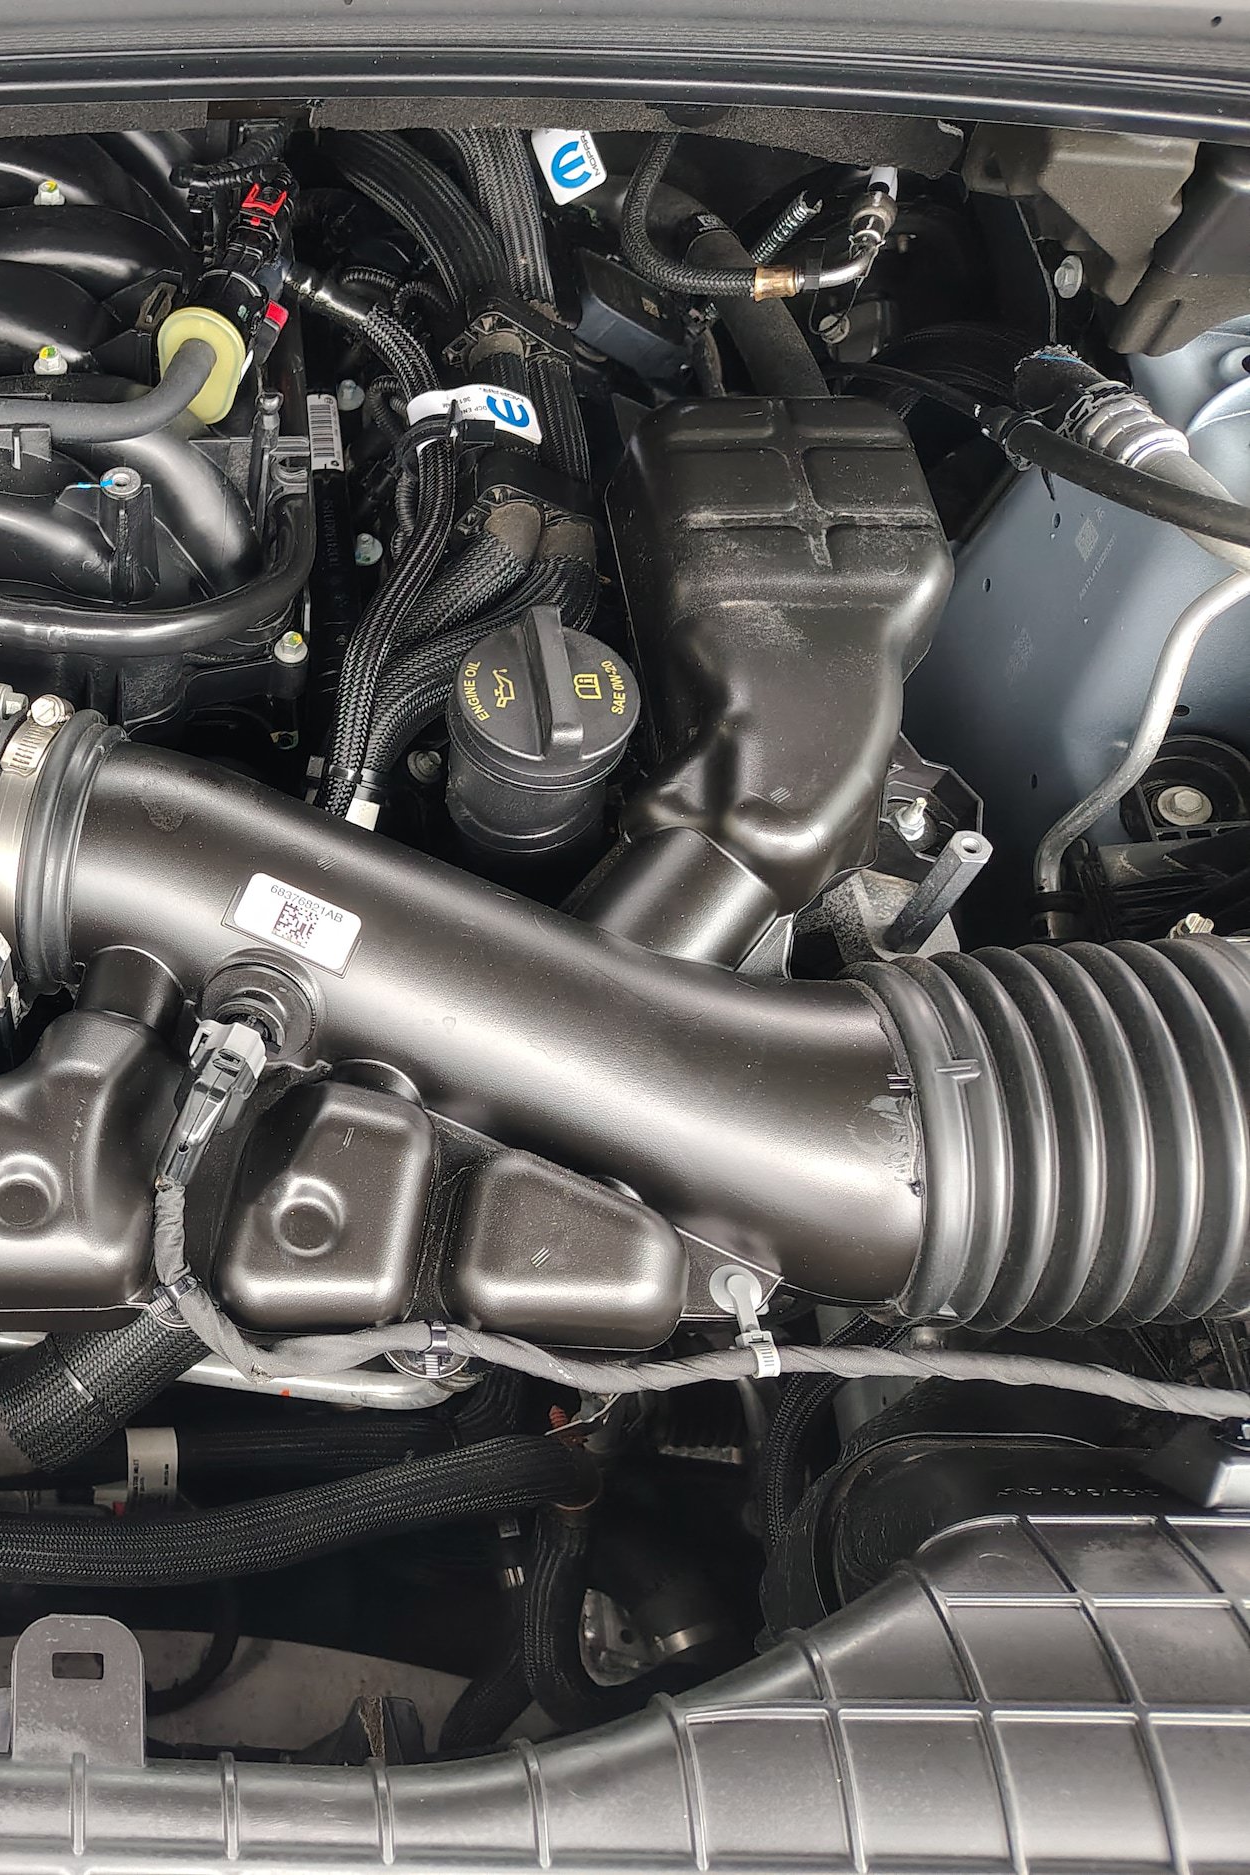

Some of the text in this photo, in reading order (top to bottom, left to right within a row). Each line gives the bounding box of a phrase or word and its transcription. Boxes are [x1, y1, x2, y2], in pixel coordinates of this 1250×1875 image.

[463, 660, 491, 722] ENGINE OIL
[601, 660, 626, 715] SAE 0W-20
[270, 885, 343, 923] 68376821AB
